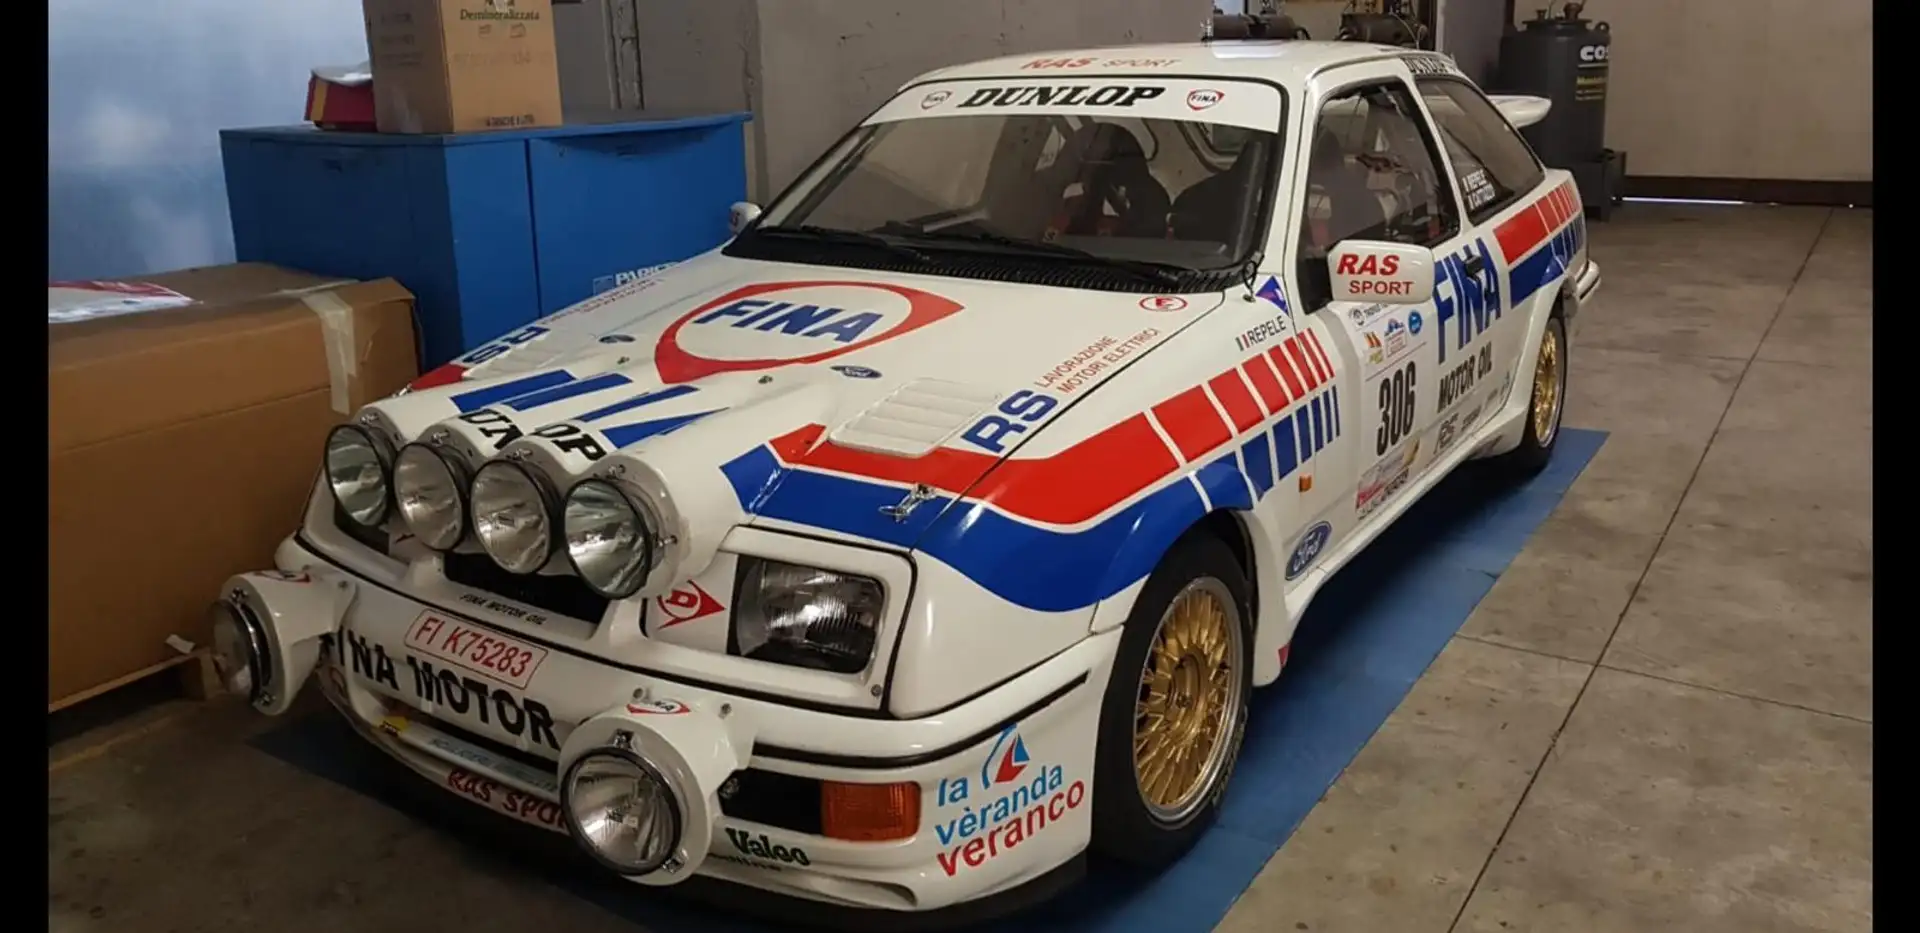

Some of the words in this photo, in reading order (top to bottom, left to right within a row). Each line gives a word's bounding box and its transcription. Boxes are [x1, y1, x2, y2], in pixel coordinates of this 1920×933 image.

[1020, 57, 1098, 69] RAS
[1102, 57, 1180, 68] SPORT
[957, 86, 1166, 107] DUNLOP
[1191, 94, 1218, 103] FINA
[1336, 253, 1400, 276] RAS
[1348, 280, 1414, 295] SPORT
[1433, 237, 1501, 364] FINA
[693, 300, 884, 343] FINA
[1247, 316, 1287, 346] REPELE
[1034, 336, 1118, 388] LAVORAZIONE
[1056, 357, 1105, 394] MOTORI
[1102, 327, 1162, 367] ELETTRICI
[1437, 355, 1476, 414] MOTOR
[1478, 341, 1492, 380] OIL
[960, 390, 1058, 453] RS
[1376, 361, 1416, 457] 306
[460, 593, 487, 607] FINA
[485, 601, 527, 618] MOTOR
[525, 613, 548, 625] OIL
[414, 616, 447, 645] FI
[441, 625, 533, 678] K75283
[406, 655, 560, 751] MOTOR
[448, 768, 497, 802] RAS
[935, 765, 1063, 846] vèranda
[938, 777, 969, 807] la
[725, 827, 811, 866] Valeo
[936, 780, 1085, 877] veranco
